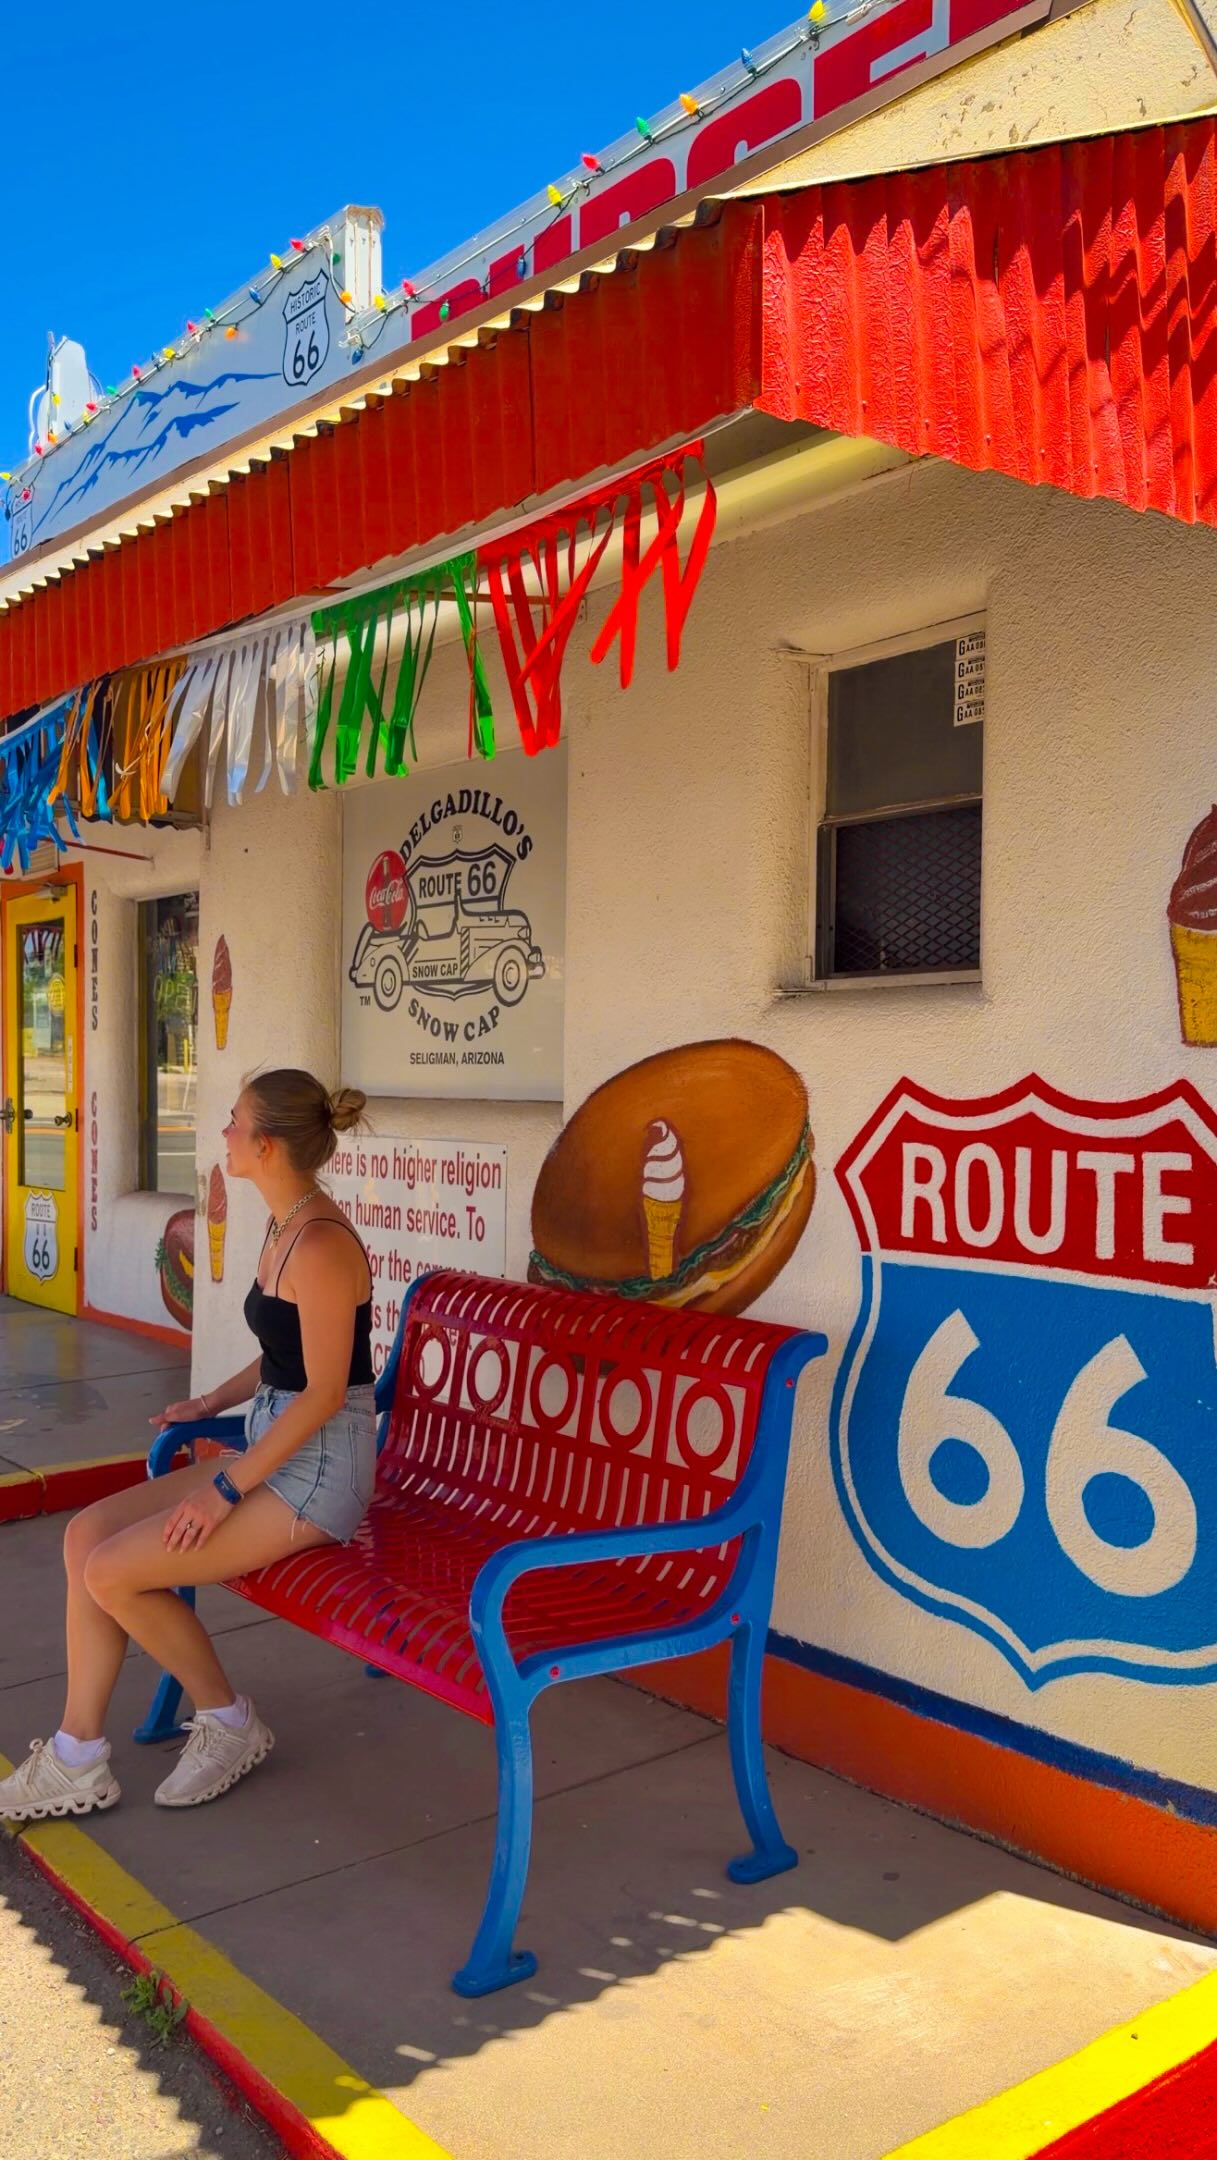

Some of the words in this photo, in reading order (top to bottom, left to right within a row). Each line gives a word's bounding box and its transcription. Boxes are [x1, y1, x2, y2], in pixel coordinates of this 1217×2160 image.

[290, 282, 321, 314] HISTORIC
[295, 311, 316, 335] ROUTE
[293, 330, 319, 379] 66
[14, 523, 27, 555] 66
[400, 789, 534, 865] DELGADILLO'S
[419, 872, 462, 899] ROUTE
[468, 861, 498, 897] 66
[412, 963, 438, 978] SNOW
[440, 962, 459, 977] CAP
[359, 996, 371, 1006] TM
[408, 998, 460, 1043] SNOW
[463, 1005, 501, 1042] CAP
[410, 1052, 459, 1068] SELIGMAN,
[461, 1051, 505, 1066] ARIZONA
[322, 1152, 353, 1176] here
[356, 1145, 367, 1177] is
[371, 1154, 388, 1179] no
[394, 1147, 437, 1190] higher
[441, 1152, 501, 1197] religion
[31, 1202, 51, 1219] ROUTE
[355, 1193, 401, 1231] human
[407, 1203, 461, 1239] service.
[466, 1206, 485, 1242] To
[902, 1140, 1195, 1265] ROUTE
[32, 1238, 50, 1270] 66
[388, 1249, 412, 1283] the
[898, 1307, 1198, 1598] 66
